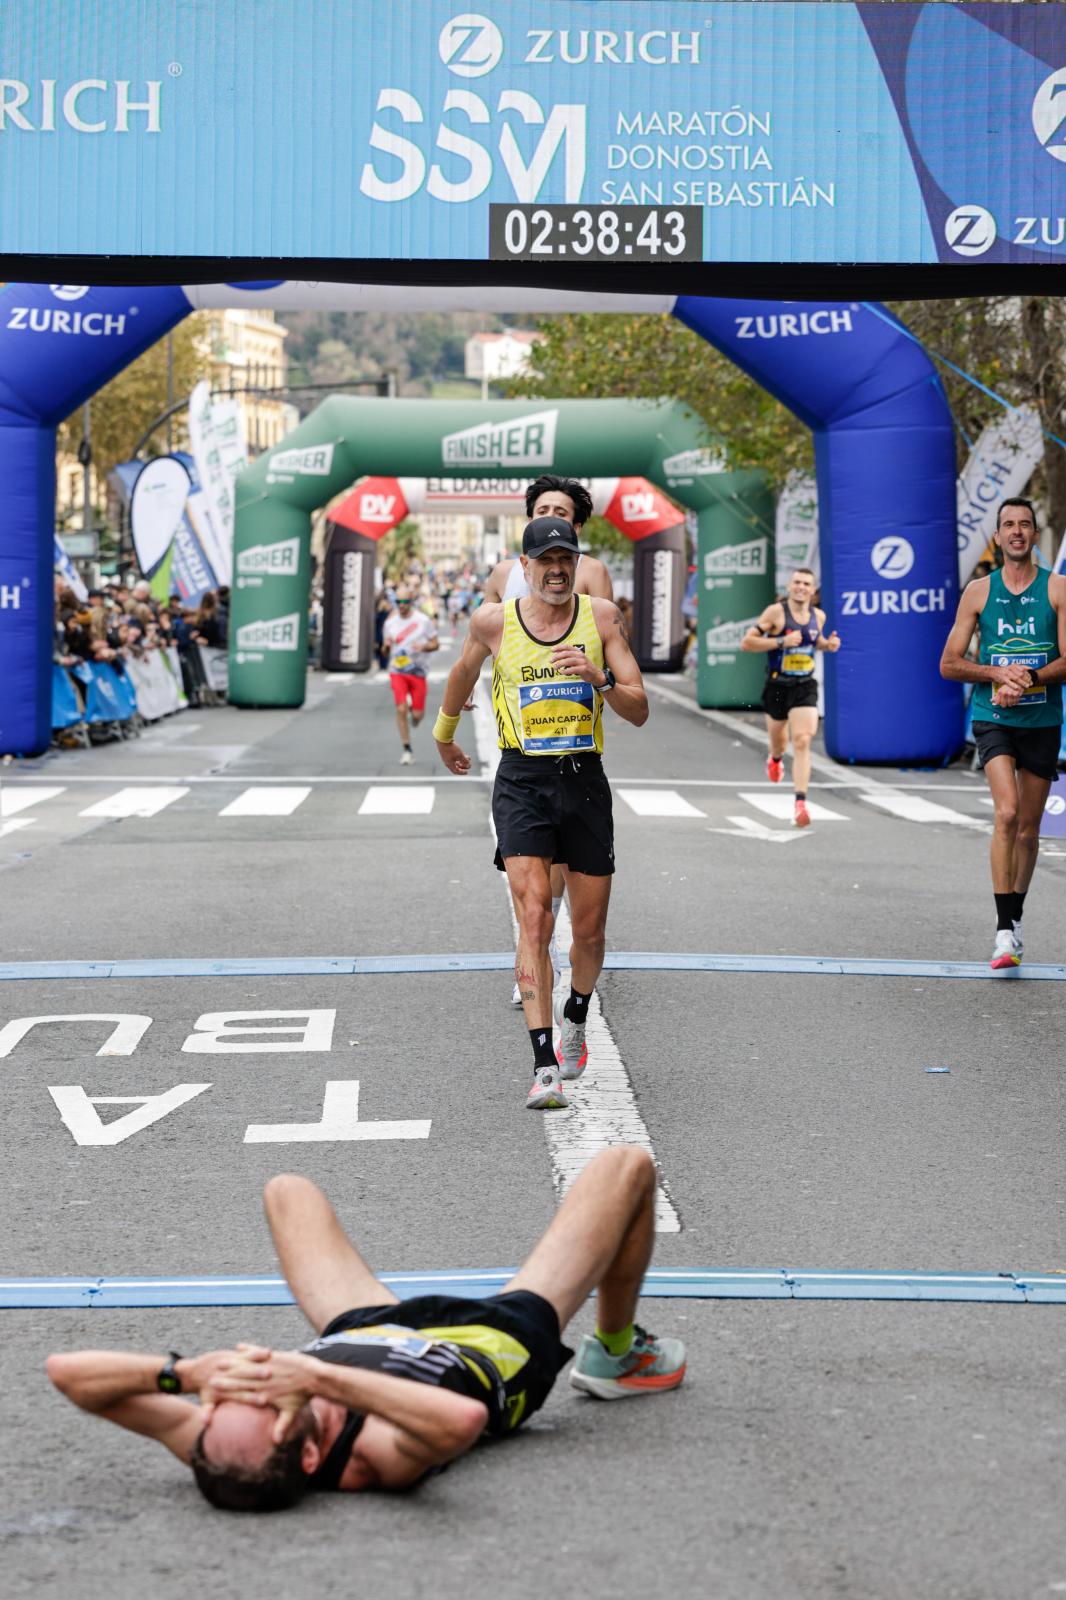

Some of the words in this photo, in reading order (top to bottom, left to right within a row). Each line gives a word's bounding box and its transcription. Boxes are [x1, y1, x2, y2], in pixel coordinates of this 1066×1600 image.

[524, 30, 700, 64] ZURICH
[0, 79, 161, 133] RICH
[616, 105, 770, 136] MARATÓN
[360, 88, 586, 204] SSM
[607, 144, 772, 170] DONOSTIA
[600, 180, 662, 205] SAN
[672, 177, 834, 207] SEBASTIÁN
[504, 209, 686, 256] 02:38:43
[6, 307, 126, 336] ZURICH
[735, 310, 853, 339] ZURICH
[447, 422, 545, 459] FINISHER
[841, 588, 945, 615] ZURICH
[547, 687, 583, 697] ZURICH
[531, 716, 555, 725] JUAN
[557, 715, 591, 723] CARLOS
[554, 727, 568, 735] 411
